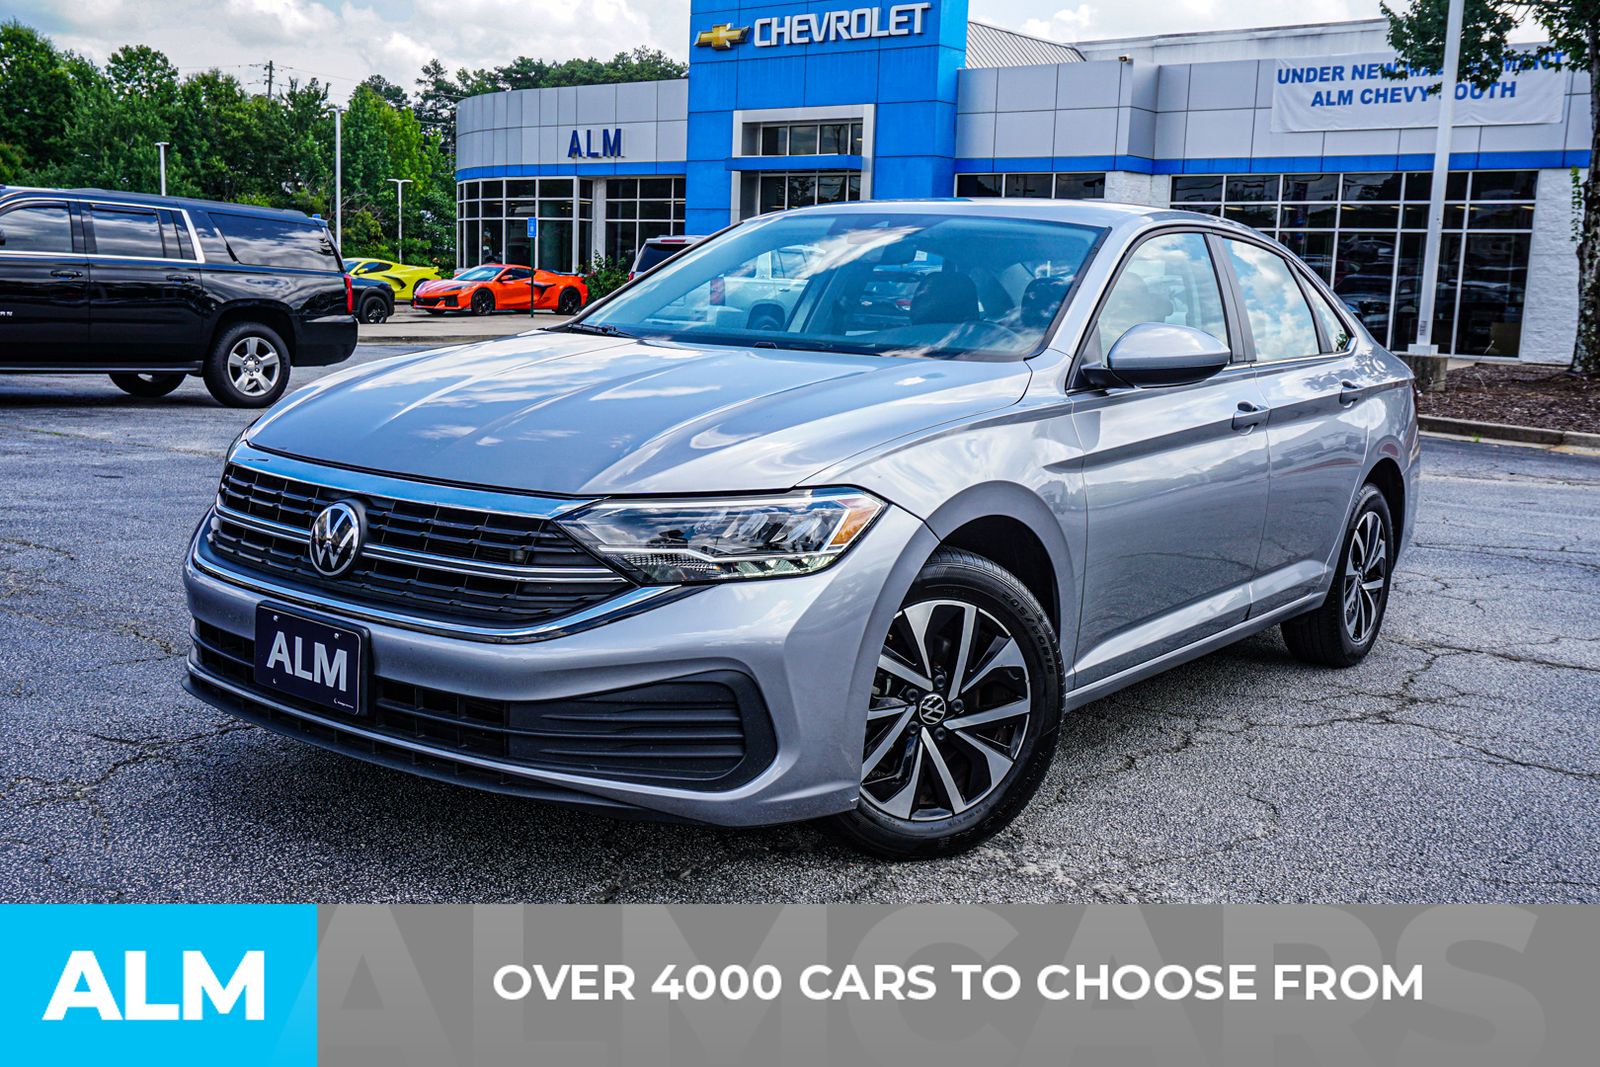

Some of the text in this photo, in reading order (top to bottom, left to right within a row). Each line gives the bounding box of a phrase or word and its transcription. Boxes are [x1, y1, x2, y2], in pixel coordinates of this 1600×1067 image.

[754, 2, 931, 47] CHEVROLET
[1277, 65, 1345, 84] UNDER
[1311, 89, 1354, 107] ALM
[1438, 81, 1517, 100] OUTH
[567, 128, 623, 158] ALM
[266, 630, 348, 692] ALM
